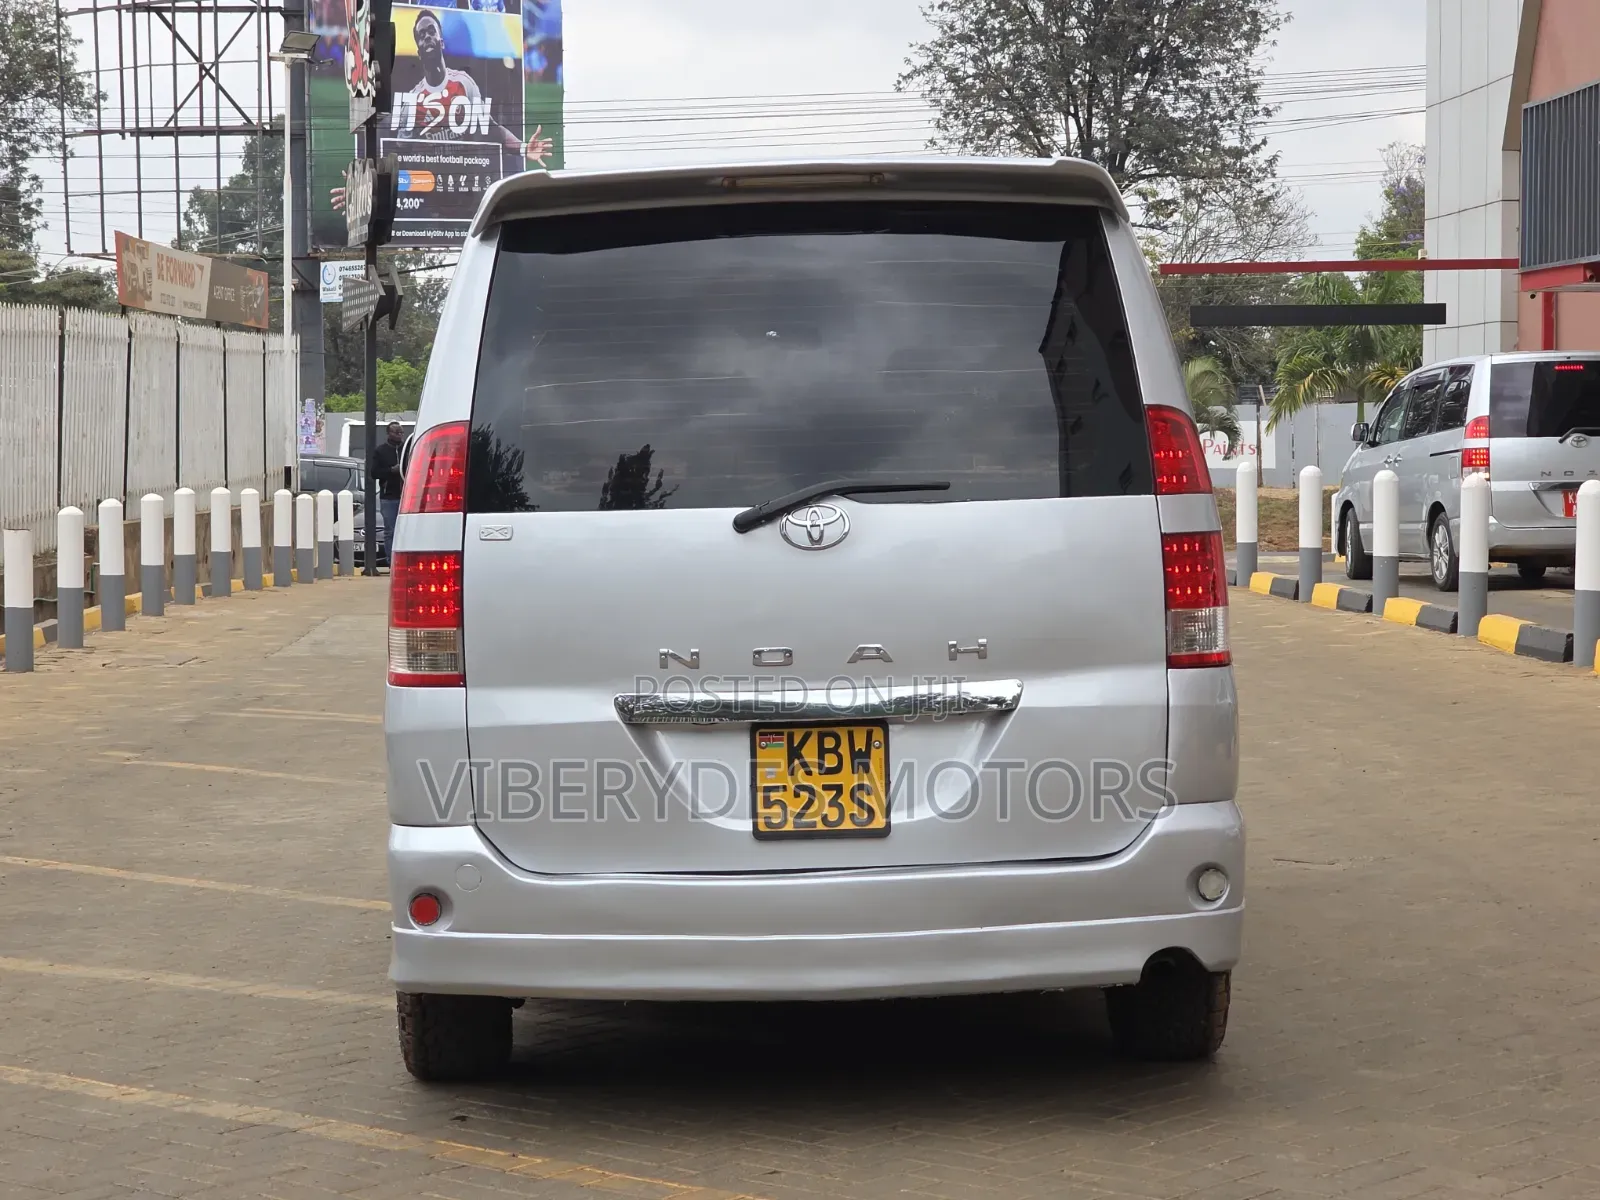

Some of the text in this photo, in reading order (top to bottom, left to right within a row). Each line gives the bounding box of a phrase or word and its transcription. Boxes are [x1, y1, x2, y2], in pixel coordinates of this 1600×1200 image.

[448, 95, 492, 135] ON
[403, 154, 425, 163] world's
[425, 155, 439, 163] best
[439, 154, 463, 164] football
[463, 156, 490, 167] package
[444, 230, 455, 239] App
[156, 252, 196, 289] BE FORWARD
[1540, 470, 1599, 478] NOA
[659, 637, 988, 670] NOAH
[786, 728, 874, 776] KBW
[762, 783, 876, 830] 523S
